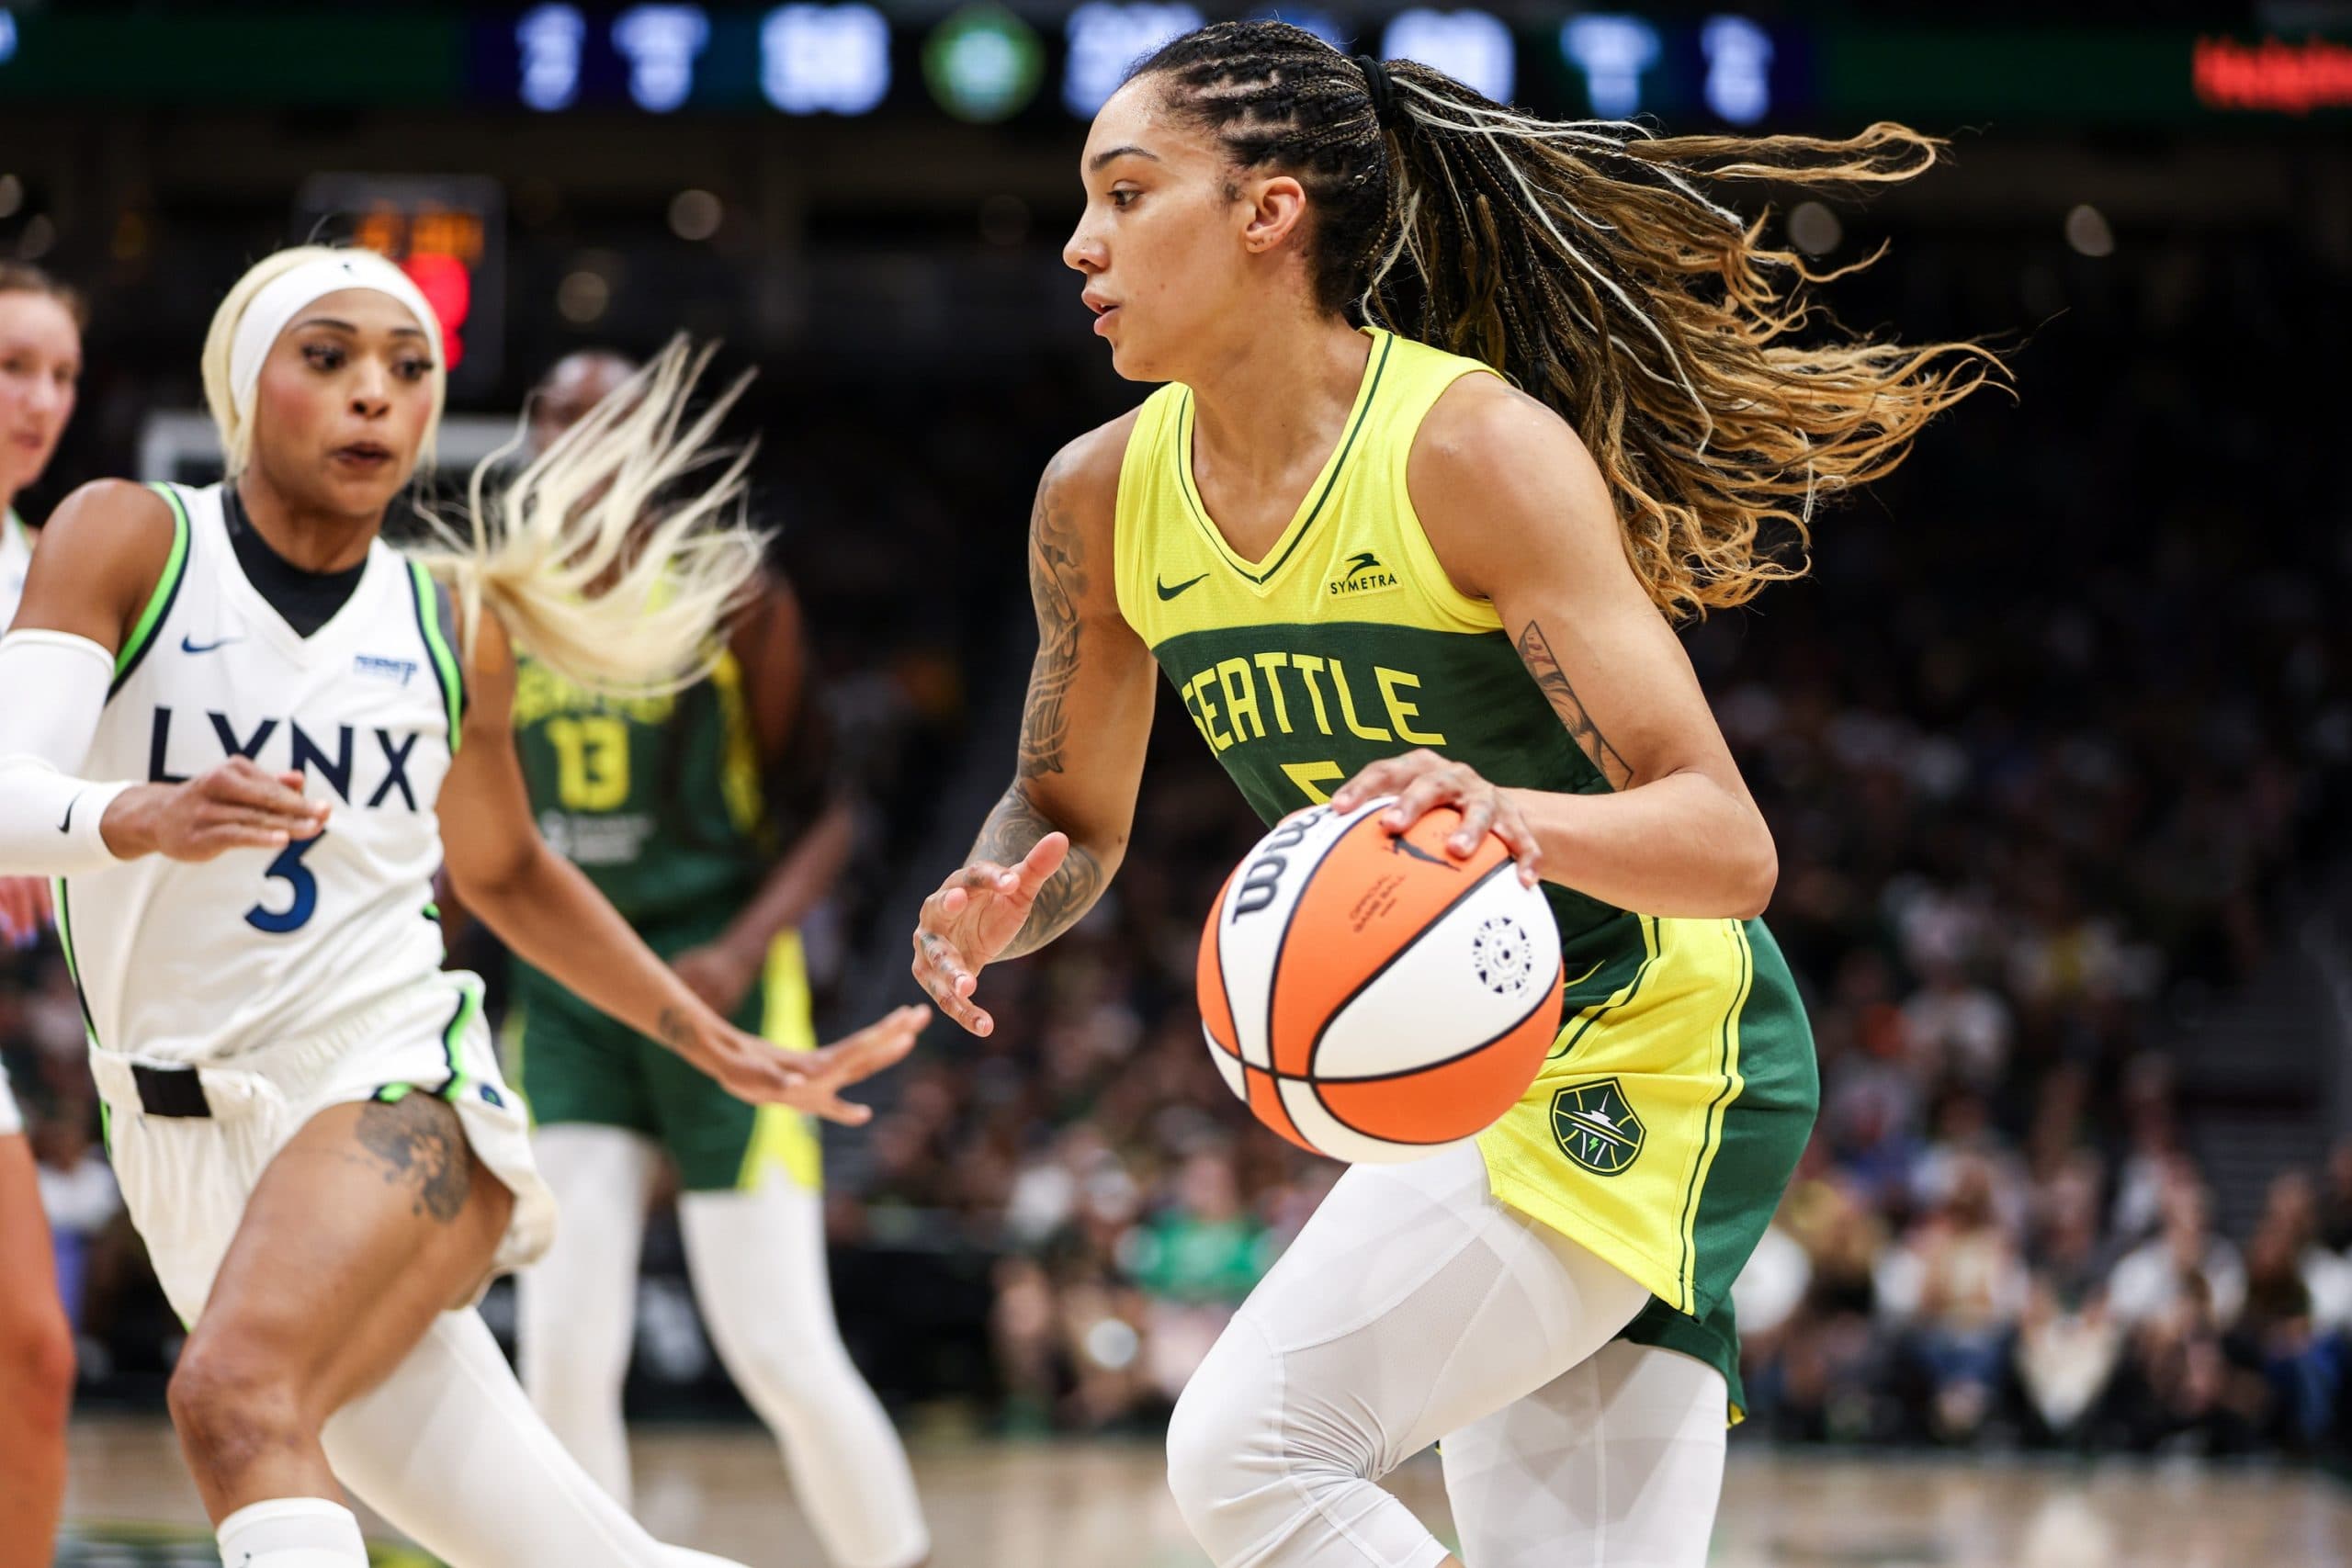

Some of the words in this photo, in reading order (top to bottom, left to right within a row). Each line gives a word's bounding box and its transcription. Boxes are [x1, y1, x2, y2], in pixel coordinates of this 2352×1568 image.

[1330, 573, 1397, 595] SYMETRA
[148, 705, 420, 812] LYNX
[547, 716, 630, 810] 13
[243, 829, 318, 933] 3
